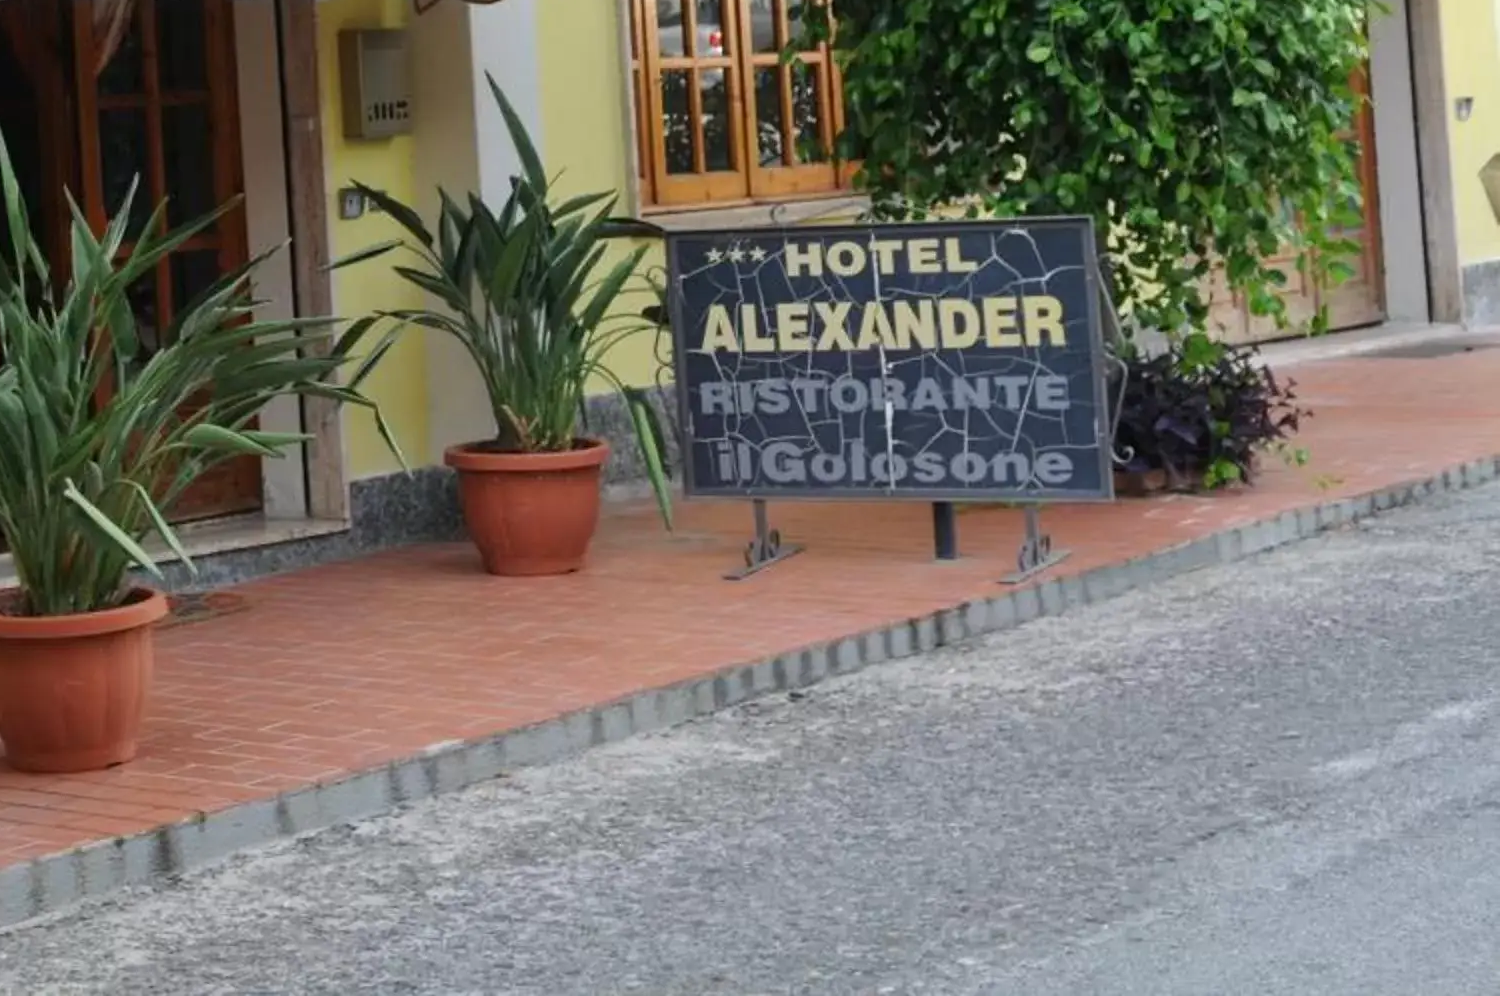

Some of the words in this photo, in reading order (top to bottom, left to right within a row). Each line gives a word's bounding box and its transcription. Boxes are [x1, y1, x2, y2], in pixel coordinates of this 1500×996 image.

[784, 237, 978, 277] HOTEL
[700, 294, 1067, 352] ALEXANDER
[700, 374, 1071, 414] RISTORANTE
